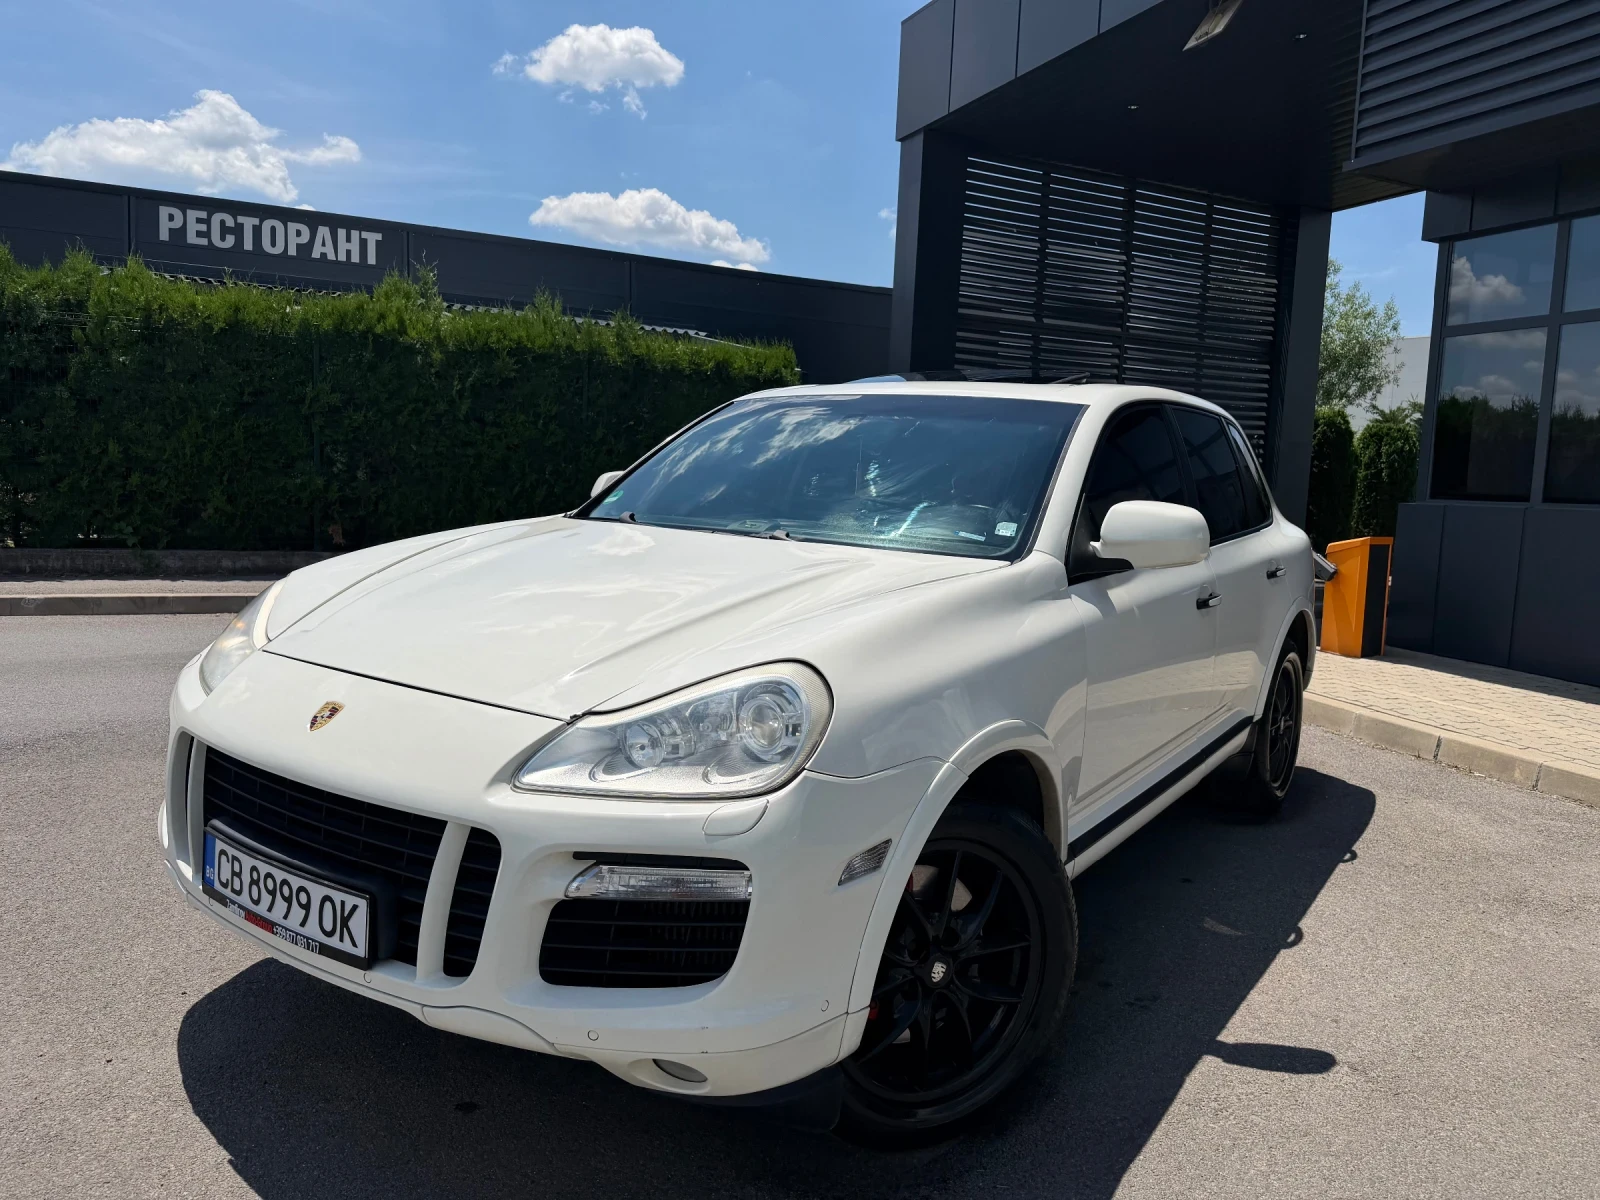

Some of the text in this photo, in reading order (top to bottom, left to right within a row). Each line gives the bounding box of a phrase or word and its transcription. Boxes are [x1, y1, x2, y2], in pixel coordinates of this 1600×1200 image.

[159, 206, 382, 265] РЕСТОРАНТ
[205, 865, 214, 880] BG
[218, 849, 359, 949] CB 8999 OK
